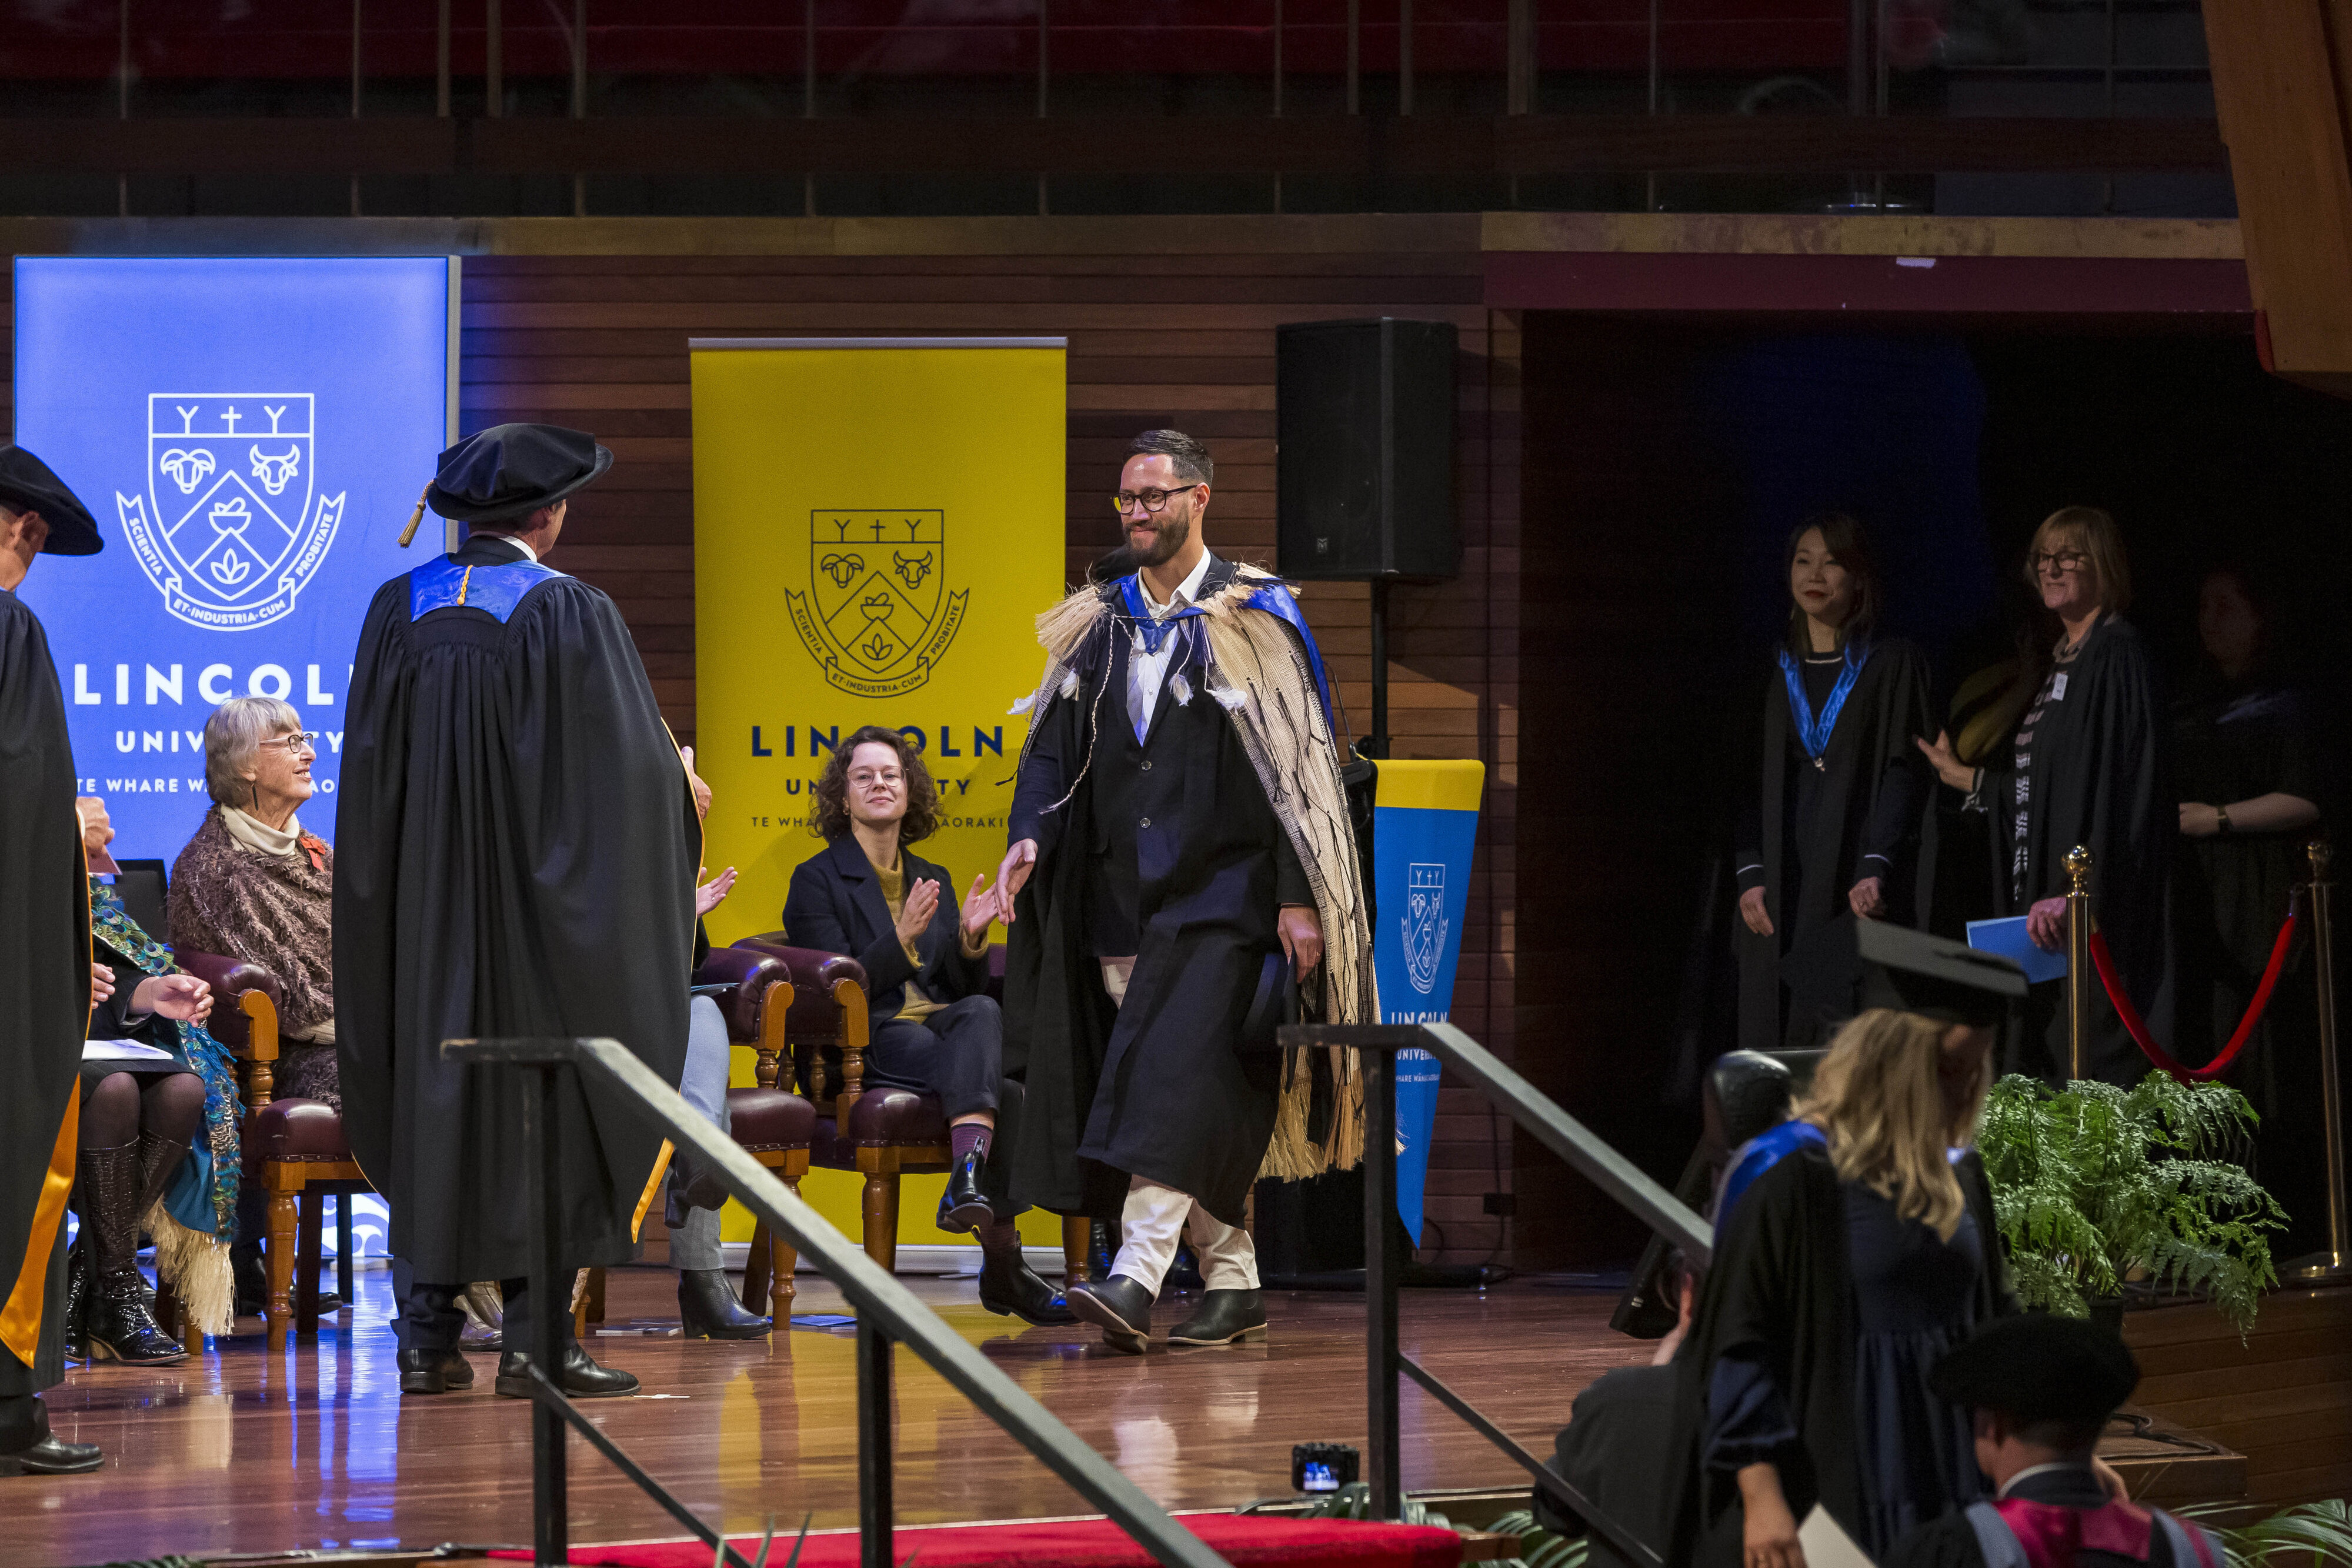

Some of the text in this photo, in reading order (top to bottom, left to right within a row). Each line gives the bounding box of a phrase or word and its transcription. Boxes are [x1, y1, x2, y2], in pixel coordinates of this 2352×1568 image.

[129, 517, 164, 576] SCIENTIA
[295, 513, 333, 577] PROBITATE
[795, 608, 822, 654] SCIENTIA
[930, 605, 960, 655] PROBITATE
[75, 663, 353, 705] LINCOL
[752, 725, 1003, 758] LINOLN
[106, 778, 179, 793] WHARE
[752, 817, 769, 827] TE
[942, 817, 1003, 828] AORAKI
